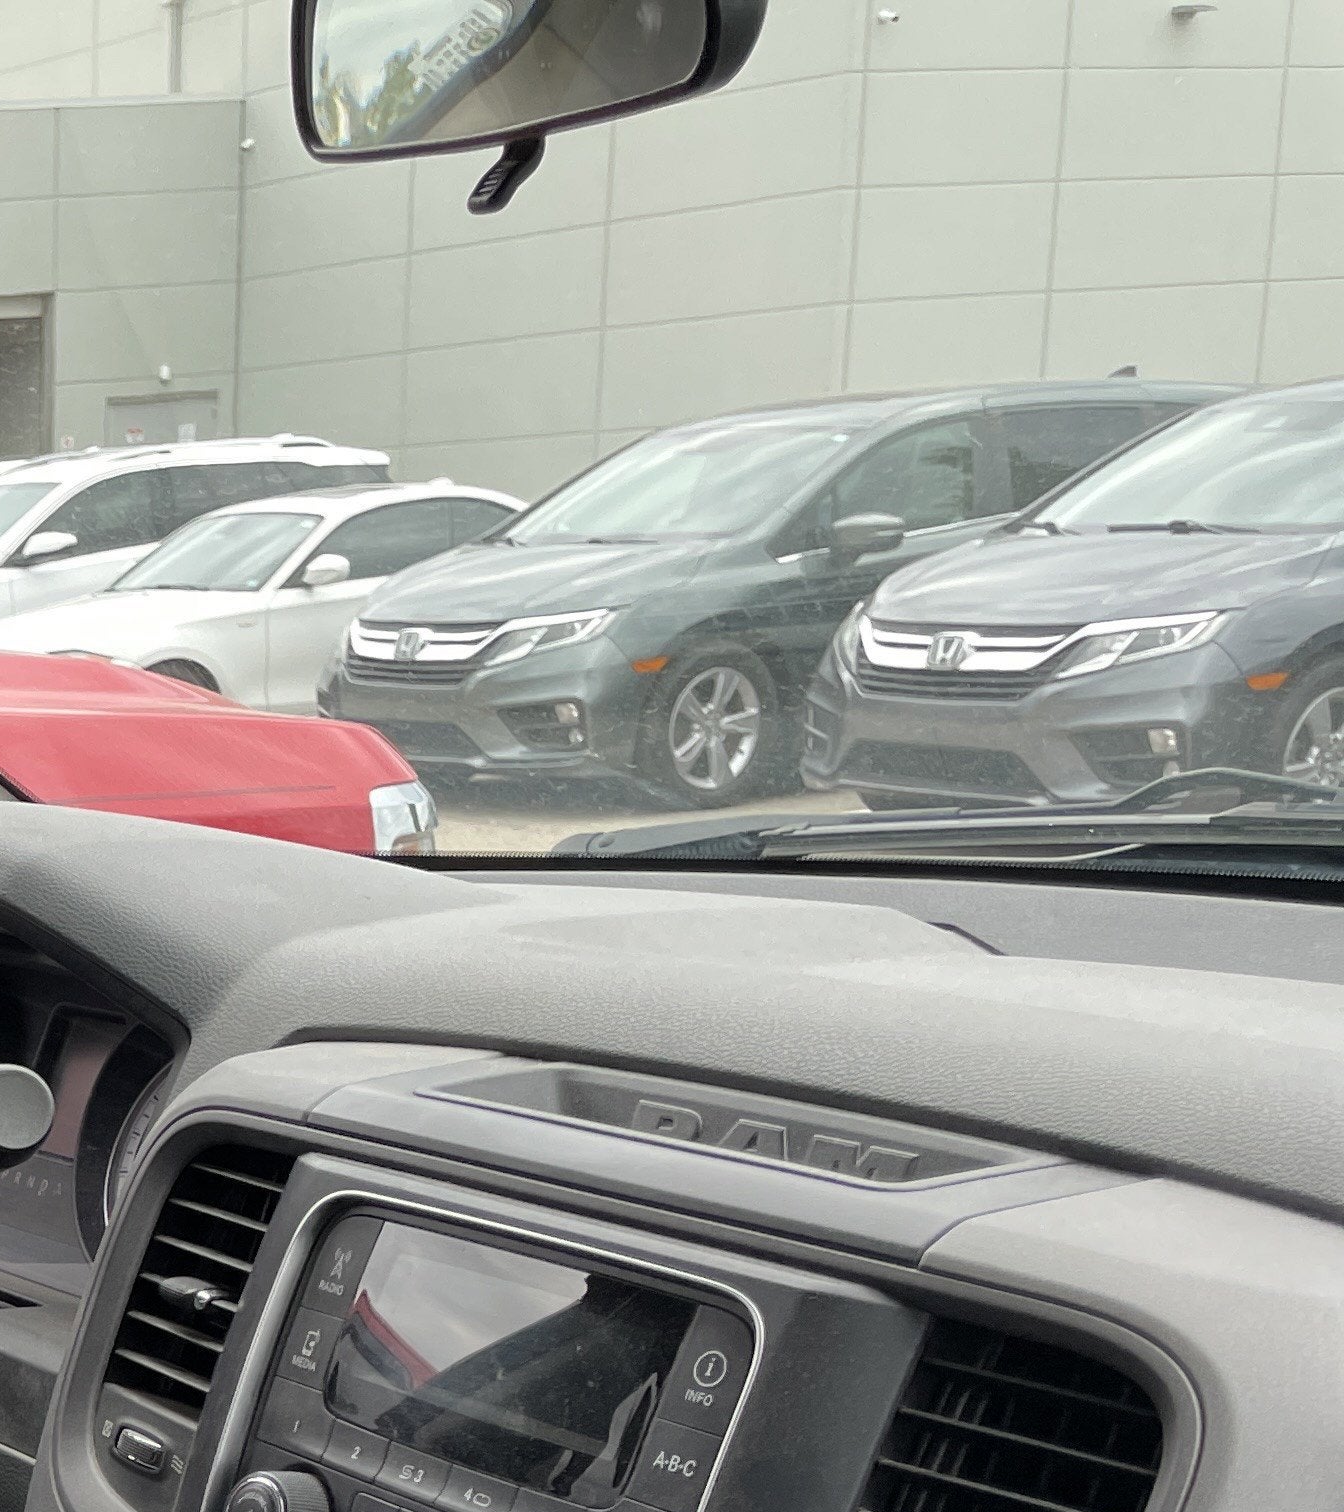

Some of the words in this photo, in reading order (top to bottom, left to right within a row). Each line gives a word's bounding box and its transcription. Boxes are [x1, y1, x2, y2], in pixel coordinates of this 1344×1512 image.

[631, 1098, 923, 1183] RAM
[318, 1279, 345, 1296] RADIO
[291, 1354, 317, 1372] MEDIA
[684, 1388, 714, 1407] INFO
[350, 1446, 362, 1460] 2
[413, 1469, 425, 1484] 3
[463, 1487, 473, 1502] 4
